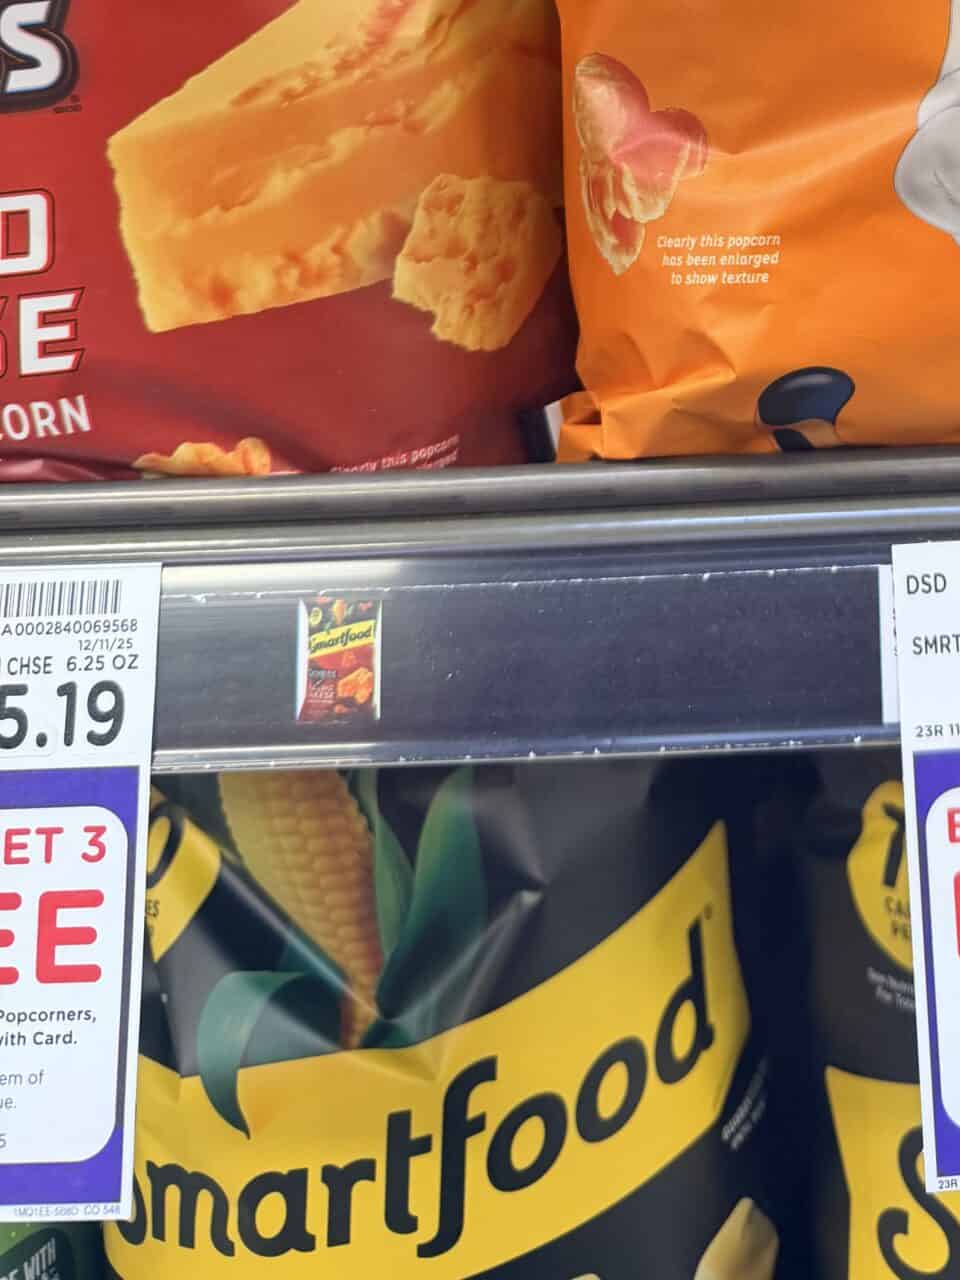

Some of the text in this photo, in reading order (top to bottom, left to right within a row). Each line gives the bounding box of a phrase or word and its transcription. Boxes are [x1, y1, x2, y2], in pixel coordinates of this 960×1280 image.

[656, 232, 781, 250] Clearly this popcorn
[662, 251, 780, 269] has been enlarged
[671, 271, 769, 286] to show texture
[0, 394, 91, 441] ORN
[906, 572, 948, 595] DSD
[1, 618, 139, 637] A0002840069568
[77, 637, 134, 652] 12/11/25
[310, 627, 372, 652] Smartfood
[7, 654, 139, 676] CHSE 6.25 OZ
[0, 679, 126, 750] 5.19
[914, 722, 944, 738] 23R
[81, 825, 108, 864] 3
[33, 1030, 78, 1046] Card.
[28, 1069, 45, 1085] of
